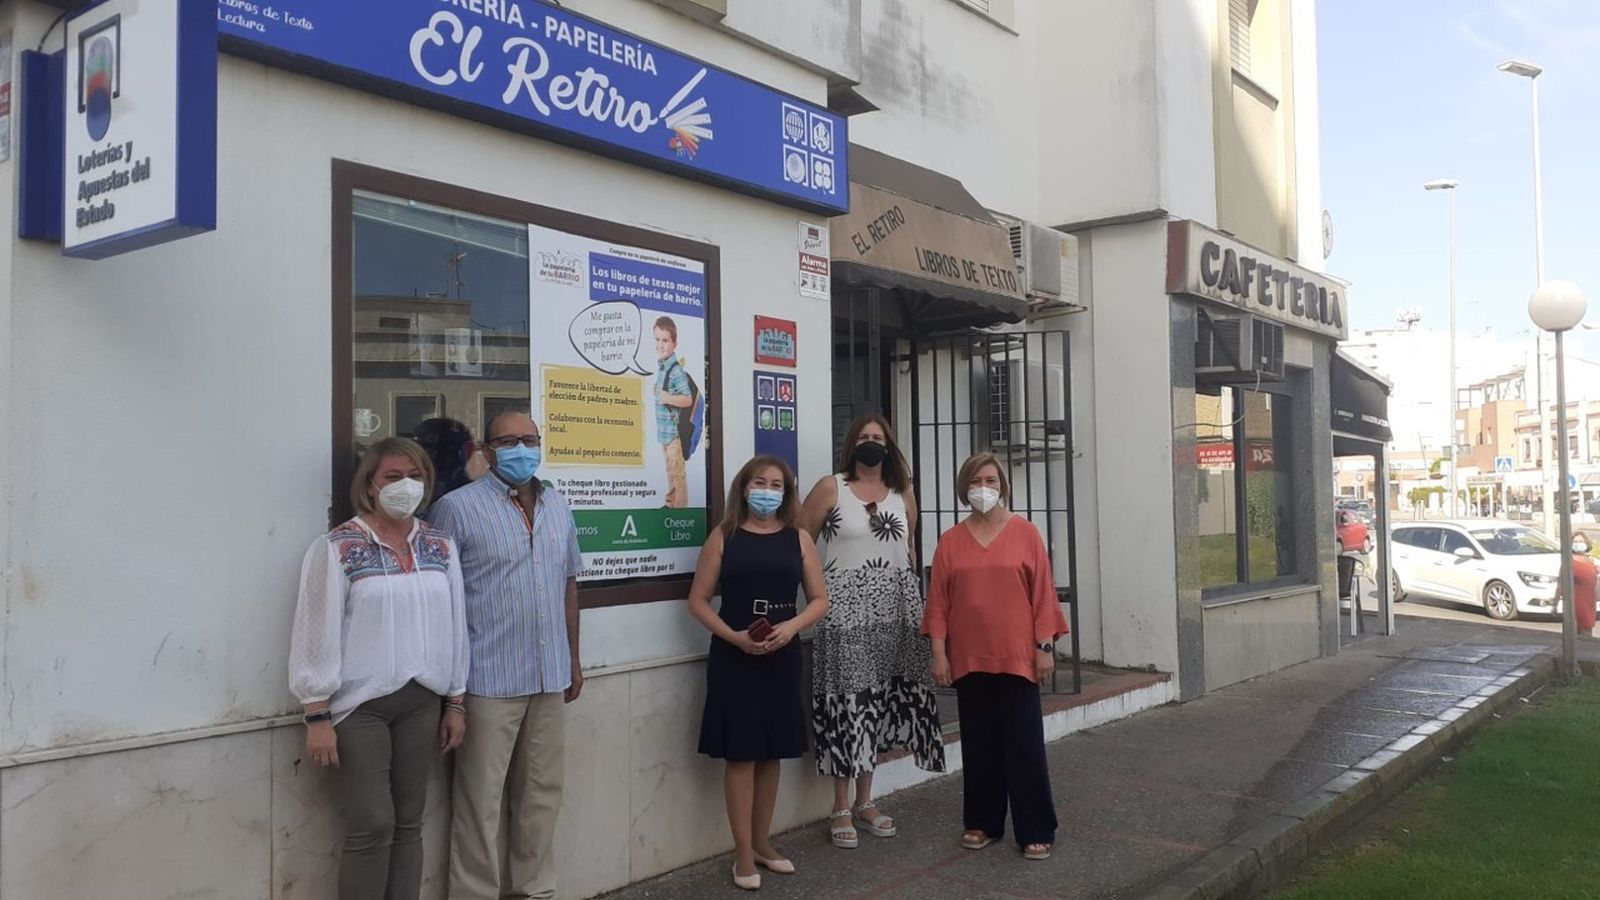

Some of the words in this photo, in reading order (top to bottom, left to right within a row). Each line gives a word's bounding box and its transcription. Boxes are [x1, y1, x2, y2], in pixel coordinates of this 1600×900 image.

[217, 7, 266, 32] Lectura
[219, 0, 258, 15] ibros
[262, 6, 280, 20] de
[284, 11, 314, 30] Texto
[545, 15, 657, 76] PAPELERÍA
[409, 10, 484, 85] El
[502, 37, 658, 134] Retiro
[77, 142, 123, 175] Loterías
[125, 140, 133, 163] y
[77, 169, 130, 204] Apuestas
[131, 156, 150, 183] del
[76, 198, 115, 228] Estado
[852, 231, 871, 256] EL
[866, 205, 906, 244] RETIRO
[801, 255, 827, 269] Alarma
[914, 246, 961, 280] LIBROS
[961, 258, 980, 284] DE
[980, 263, 1017, 293] TEXTO
[592, 266, 609, 278] Los
[610, 270, 637, 284] libros
[638, 275, 650, 286] de
[652, 278, 675, 290] texto
[676, 282, 701, 295] mejor
[1200, 240, 1343, 329] CAFETERIA
[592, 280, 606, 290] en
[607, 282, 618, 292] tu
[619, 284, 661, 299] papelería
[663, 291, 674, 301] de
[675, 293, 703, 307] barrio.
[590, 312, 602, 322] Me
[603, 311, 622, 325] gusta
[584, 326, 613, 339] comprar
[615, 326, 624, 334] en
[624, 323, 631, 333] la
[617, 337, 626, 348] de
[626, 338, 636, 347] mi
[601, 352, 622, 362] barrio
[549, 380, 579, 390] Favorece
[580, 381, 586, 391] la
[587, 382, 613, 393] libertad
[549, 392, 576, 401] elección
[587, 394, 609, 404] padres
[614, 397, 640, 406] madres.
[549, 413, 583, 423] Colaboras
[597, 417, 603, 425] la
[549, 425, 567, 433] local.
[549, 447, 575, 456] Ayudas
[575, 448, 582, 456] al
[582, 448, 610, 459] pequeño
[611, 450, 642, 458] comercio.
[557, 479, 566, 487] Tu
[567, 479, 593, 489] cheque
[594, 479, 611, 487] libro
[611, 480, 648, 489] gestionado
[567, 488, 589, 496] forma
[590, 487, 628, 498] profesional
[634, 489, 656, 498] segura
[573, 498, 605, 506] minutos.
[664, 517, 695, 529] Cheque
[670, 531, 691, 541] Libro
[592, 557, 604, 566] NO
[605, 556, 624, 567] dejes
[625, 556, 638, 566] que
[638, 554, 658, 564] nadie
[605, 567, 613, 576] tu
[614, 566, 639, 576] cheque
[640, 563, 656, 572] libro
[656, 564, 668, 573] por
[669, 563, 675, 571] ti
